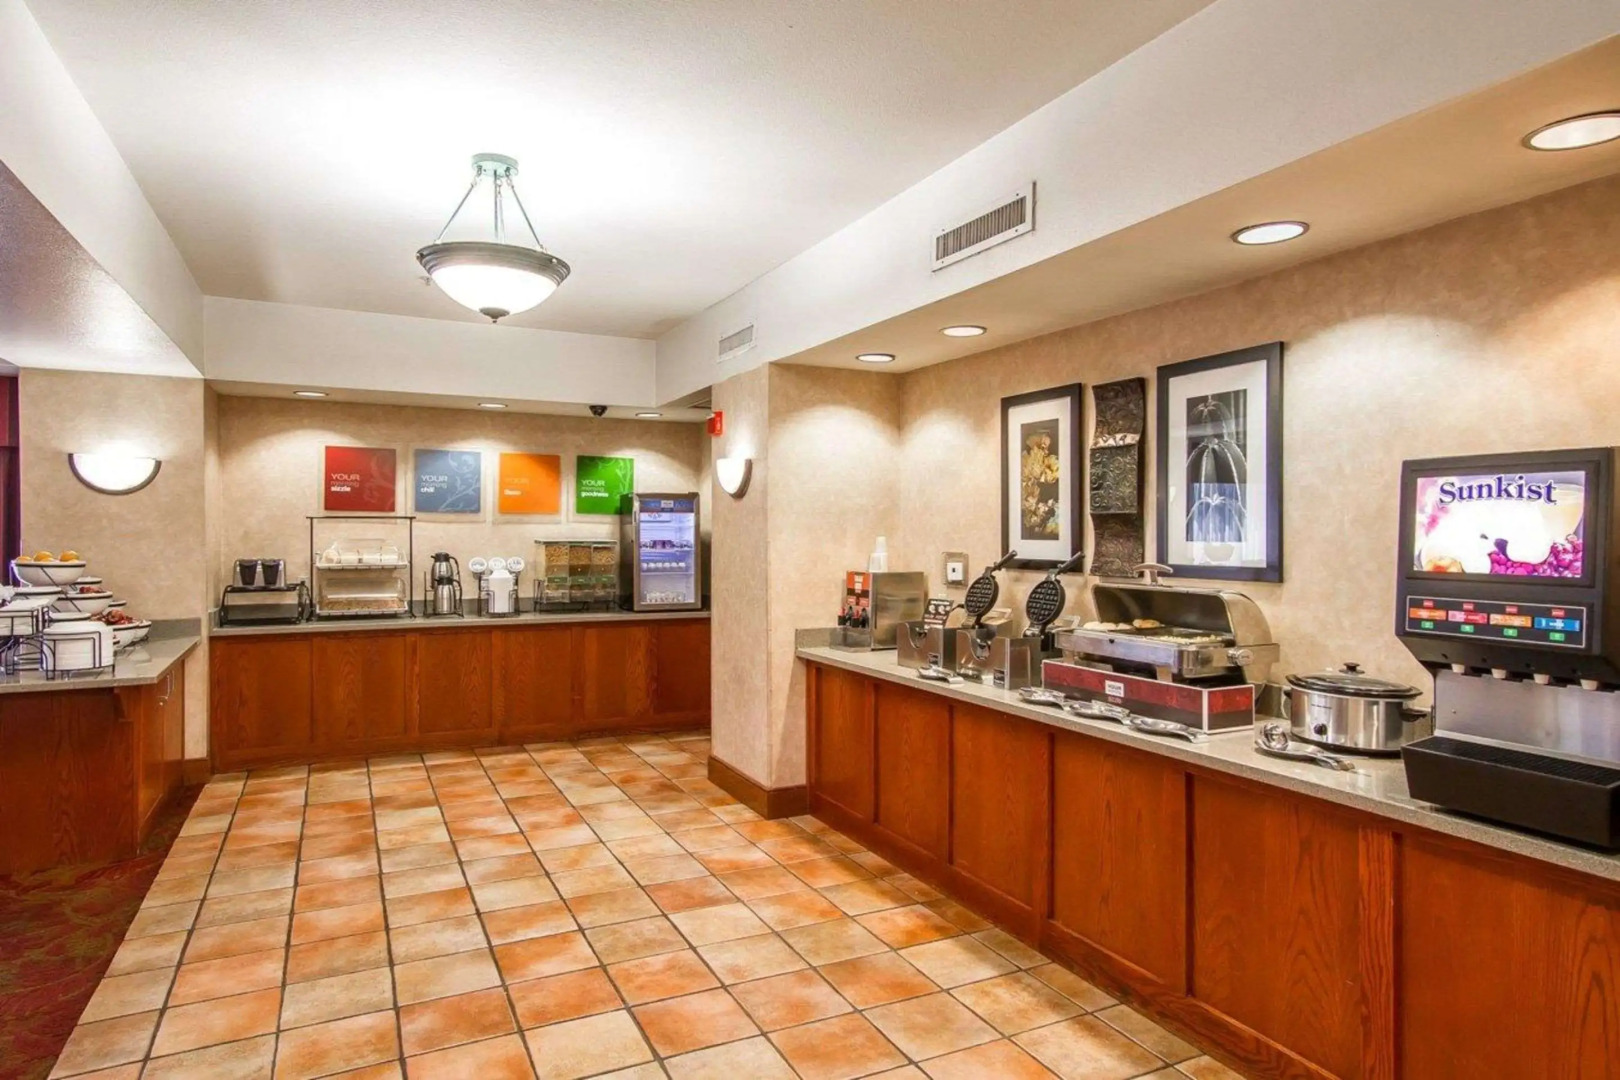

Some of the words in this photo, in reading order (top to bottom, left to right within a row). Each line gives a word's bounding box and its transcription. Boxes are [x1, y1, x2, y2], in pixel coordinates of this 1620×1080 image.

[331, 473, 360, 481] YOUR
[421, 474, 448, 482] YOUR
[581, 479, 606, 487] YOUR
[1439, 475, 1557, 505] Sunkist
